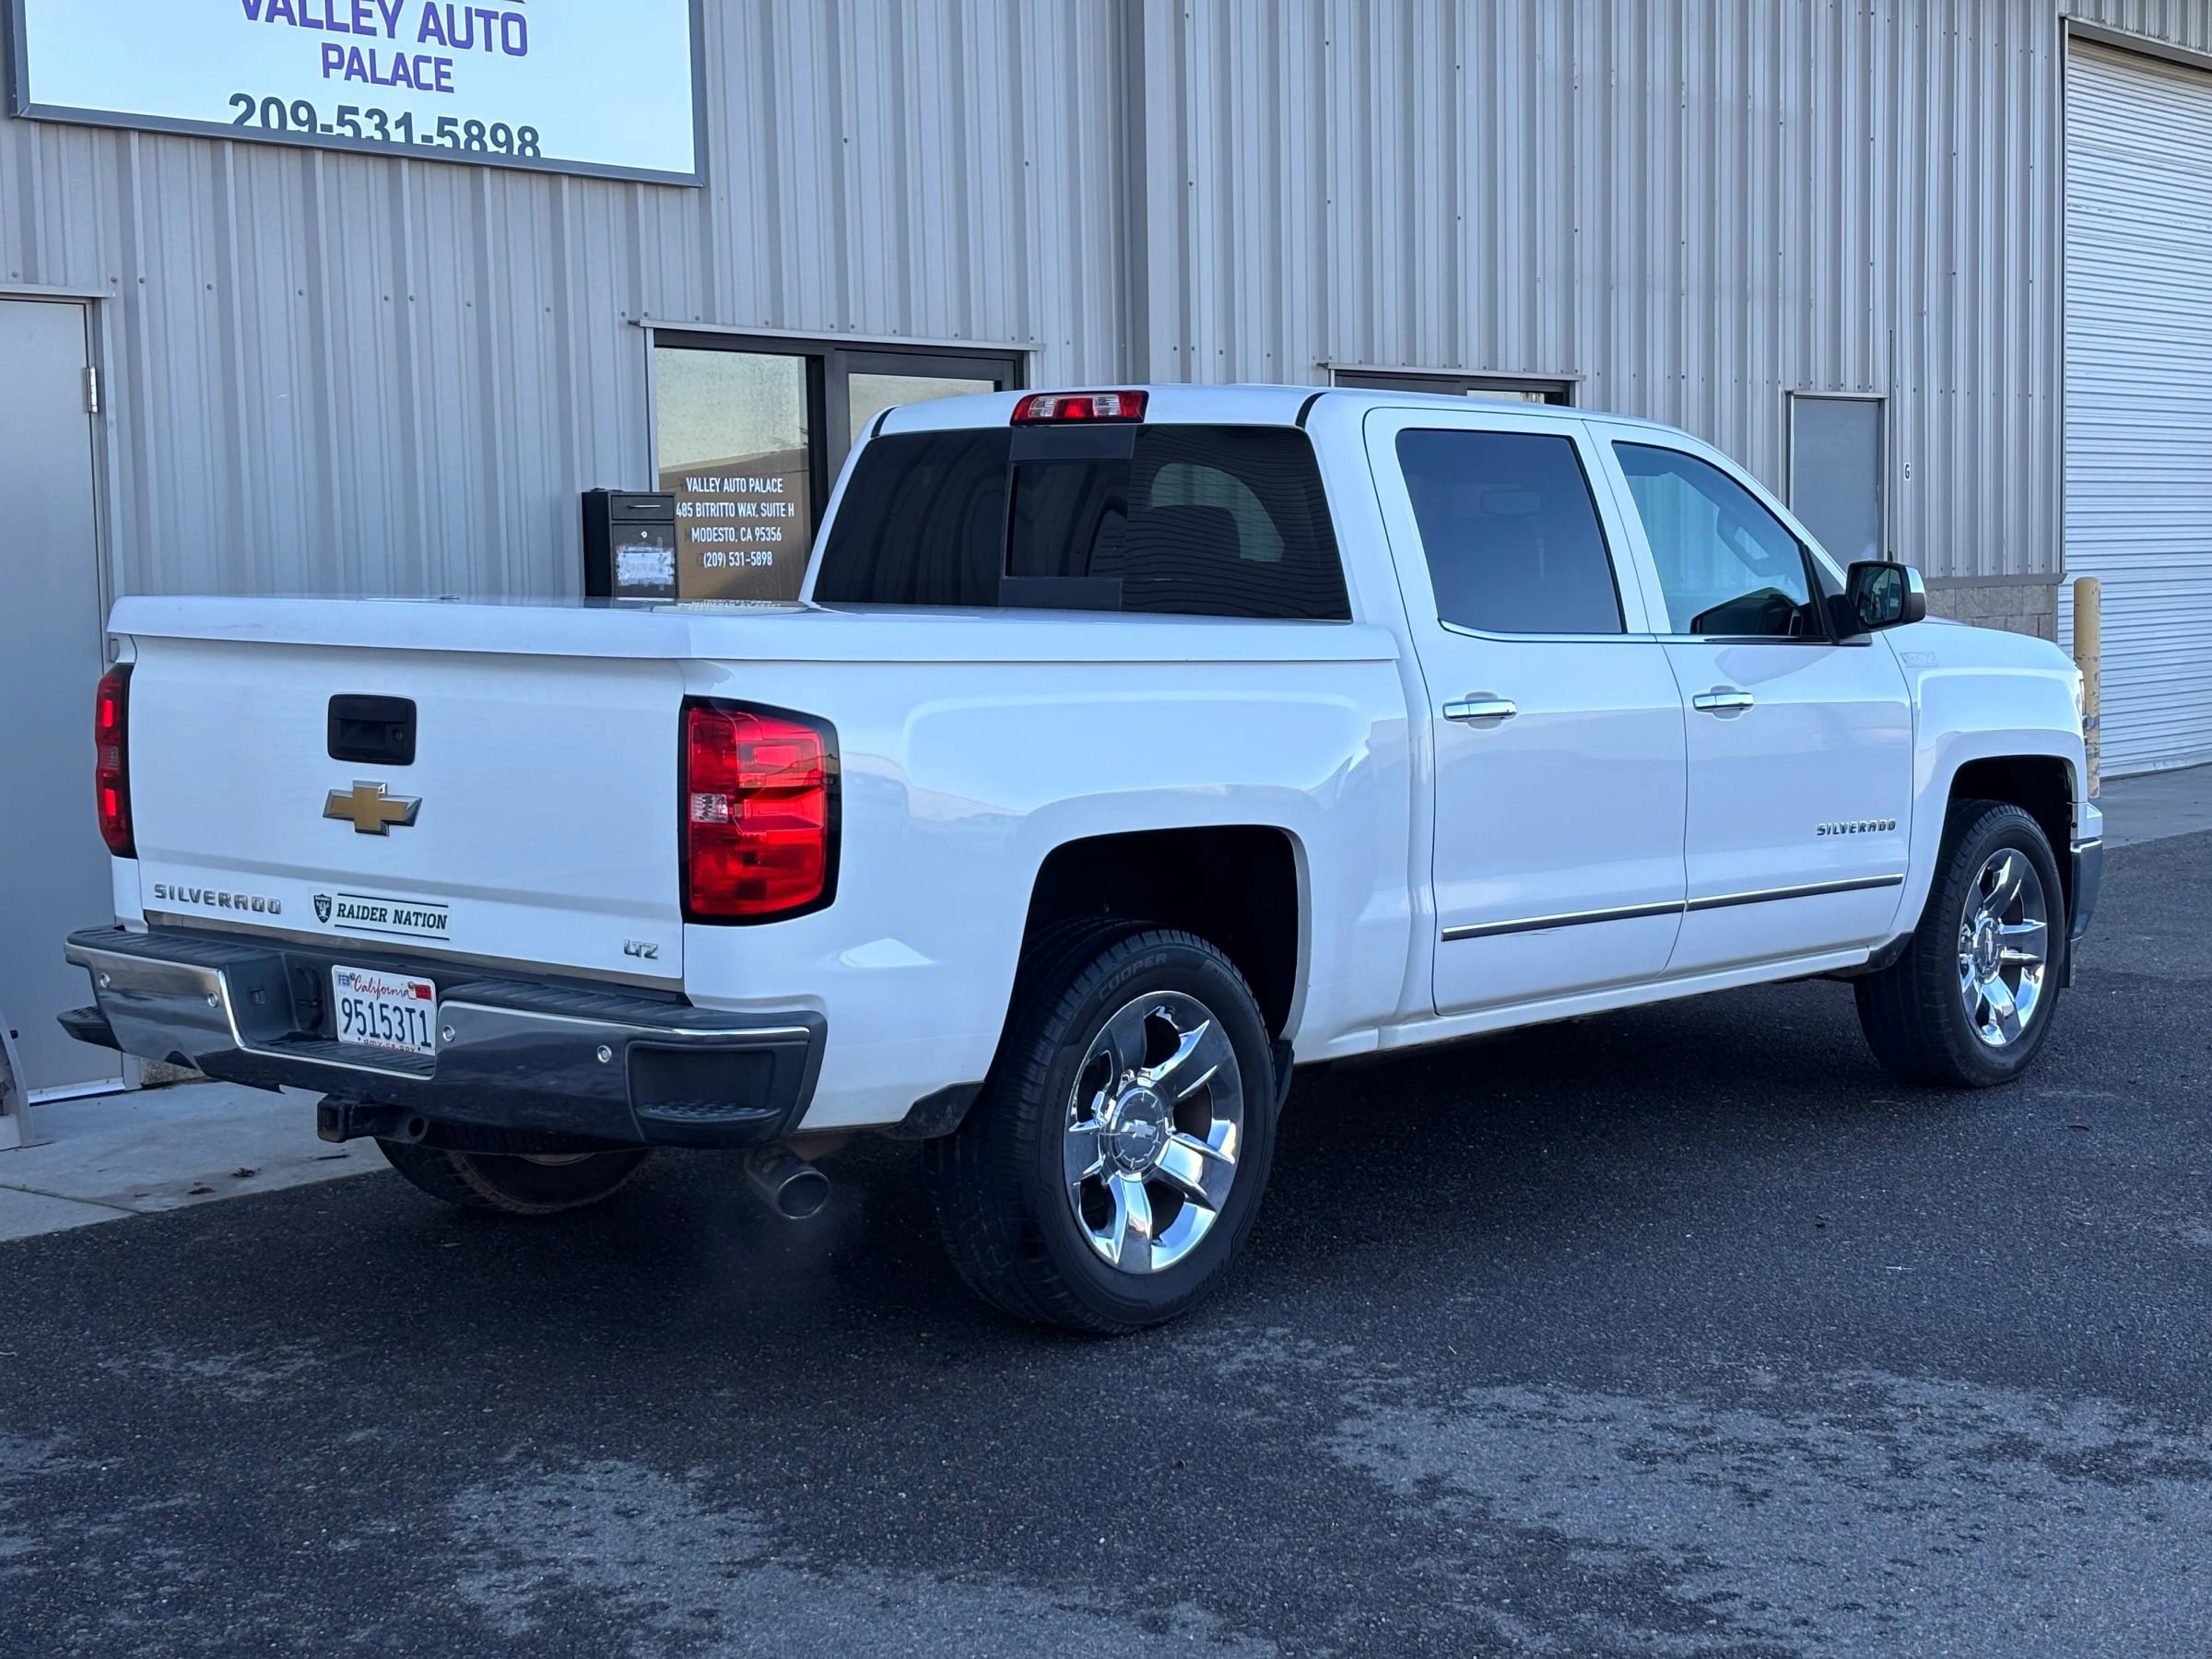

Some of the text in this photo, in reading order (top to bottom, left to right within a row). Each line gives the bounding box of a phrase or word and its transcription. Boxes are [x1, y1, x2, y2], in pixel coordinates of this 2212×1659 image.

[241, 0, 528, 57] VALLEY AUTO
[321, 42, 454, 93] PALACE
[229, 93, 541, 158] 209-531-5898
[1904, 464, 1911, 479] G
[686, 477, 783, 493] VALLEY AUTO PALACE
[676, 502, 693, 517] 485
[696, 502, 735, 517] BITRITTO
[760, 502, 786, 517] SUITE
[788, 502, 794, 517] H
[691, 527, 782, 543] MODESTO, CA 95356
[703, 552, 773, 568] (209) 531-5898
[1817, 818, 1896, 836] SILVERADO
[154, 883, 281, 914] SILVERADO
[336, 903, 448, 929] RAIDER NATION
[623, 939, 658, 959] LTZ
[338, 974, 350, 985] FEB
[354, 974, 409, 1000] California
[1099, 952, 1168, 1002] COOPER
[342, 997, 432, 1048] 95153T1
